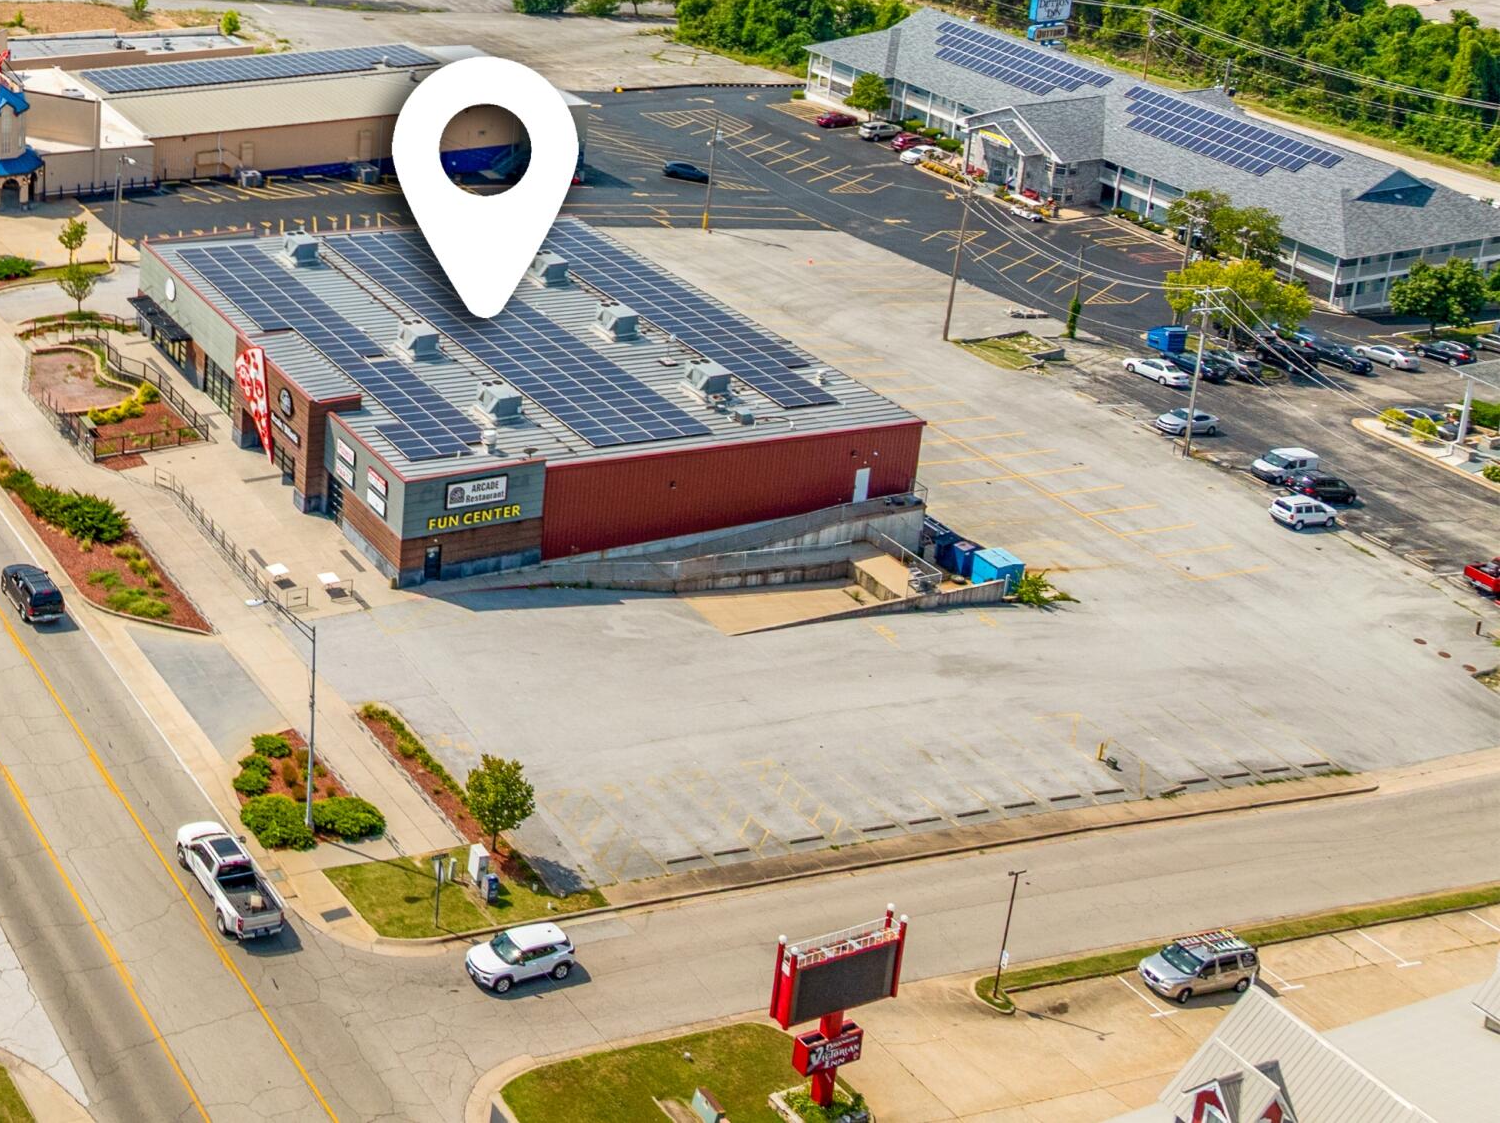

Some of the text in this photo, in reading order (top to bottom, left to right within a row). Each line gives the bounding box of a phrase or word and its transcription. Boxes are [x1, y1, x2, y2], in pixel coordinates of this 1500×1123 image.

[471, 480, 499, 493] ARCADE
[465, 490, 504, 503] Restaurant
[428, 504, 520, 530] FUN CENTER
[810, 1044, 860, 1067] VICTORIAN
[824, 1057, 846, 1069] INN
